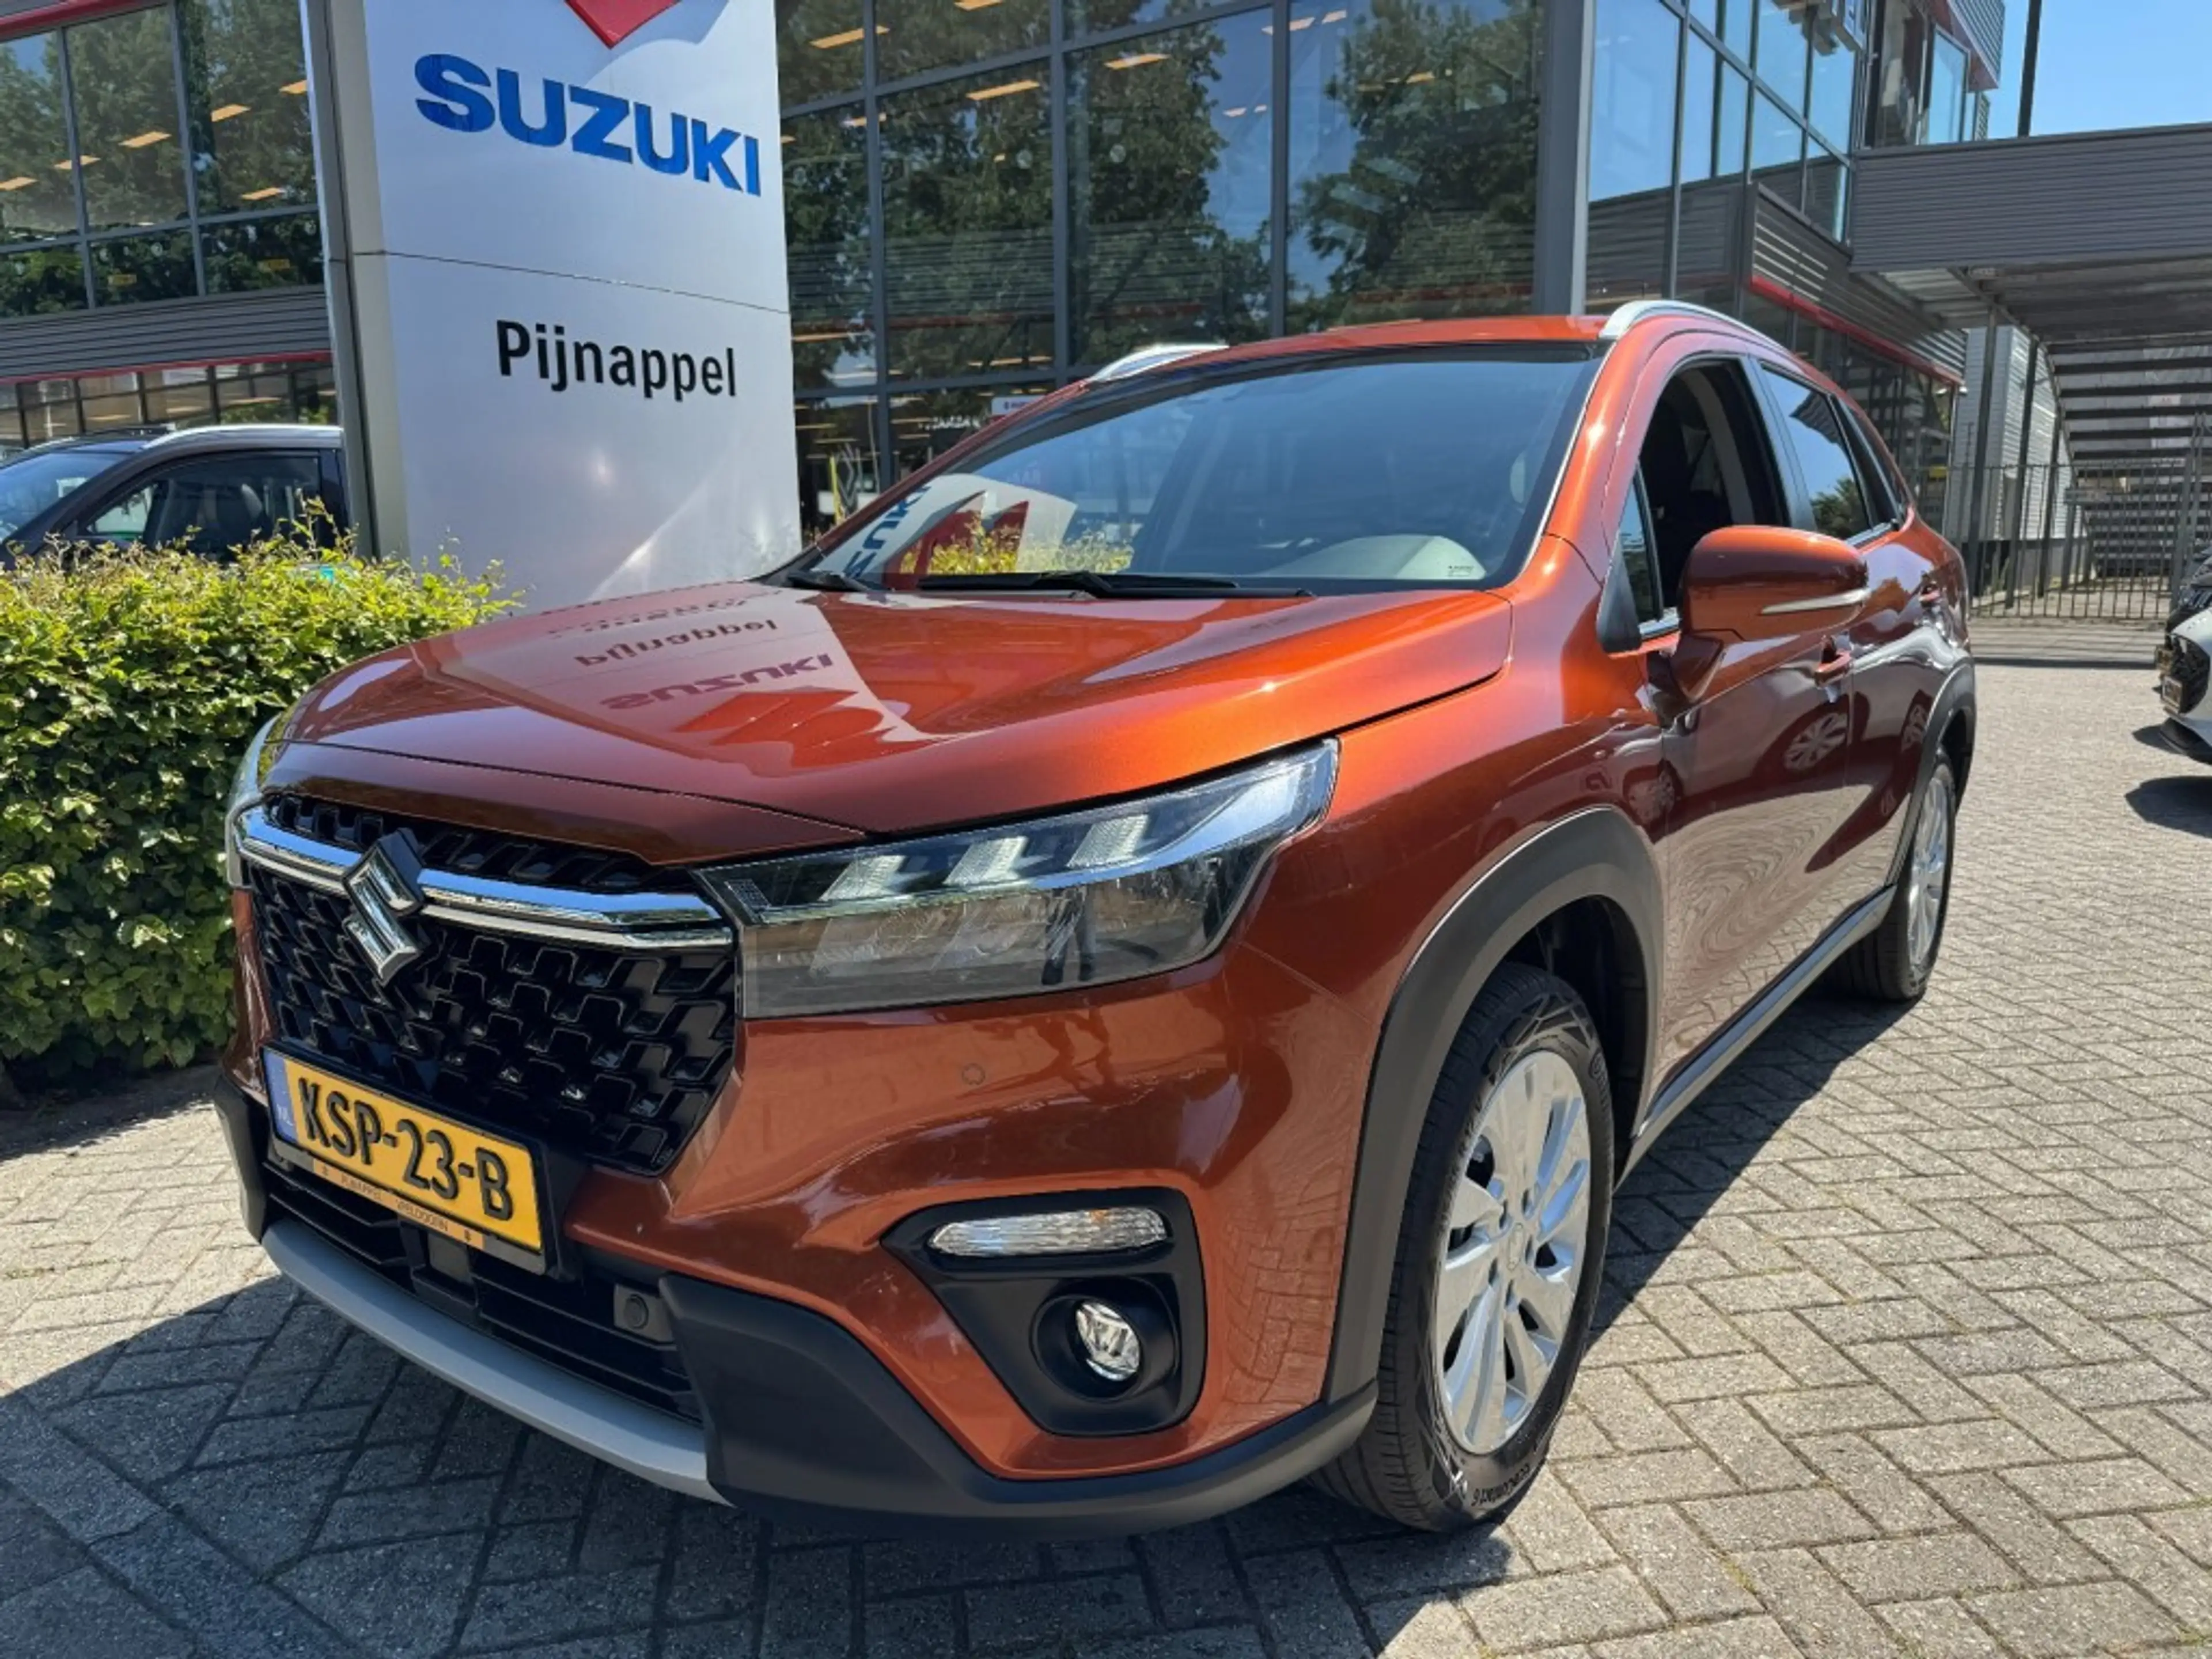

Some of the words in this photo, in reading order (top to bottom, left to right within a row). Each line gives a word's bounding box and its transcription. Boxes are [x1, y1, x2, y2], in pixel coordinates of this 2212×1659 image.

[415, 54, 761, 196] SUZUKI
[497, 320, 736, 402] Pijnappel
[298, 1077, 513, 1221] KSP-23-B
